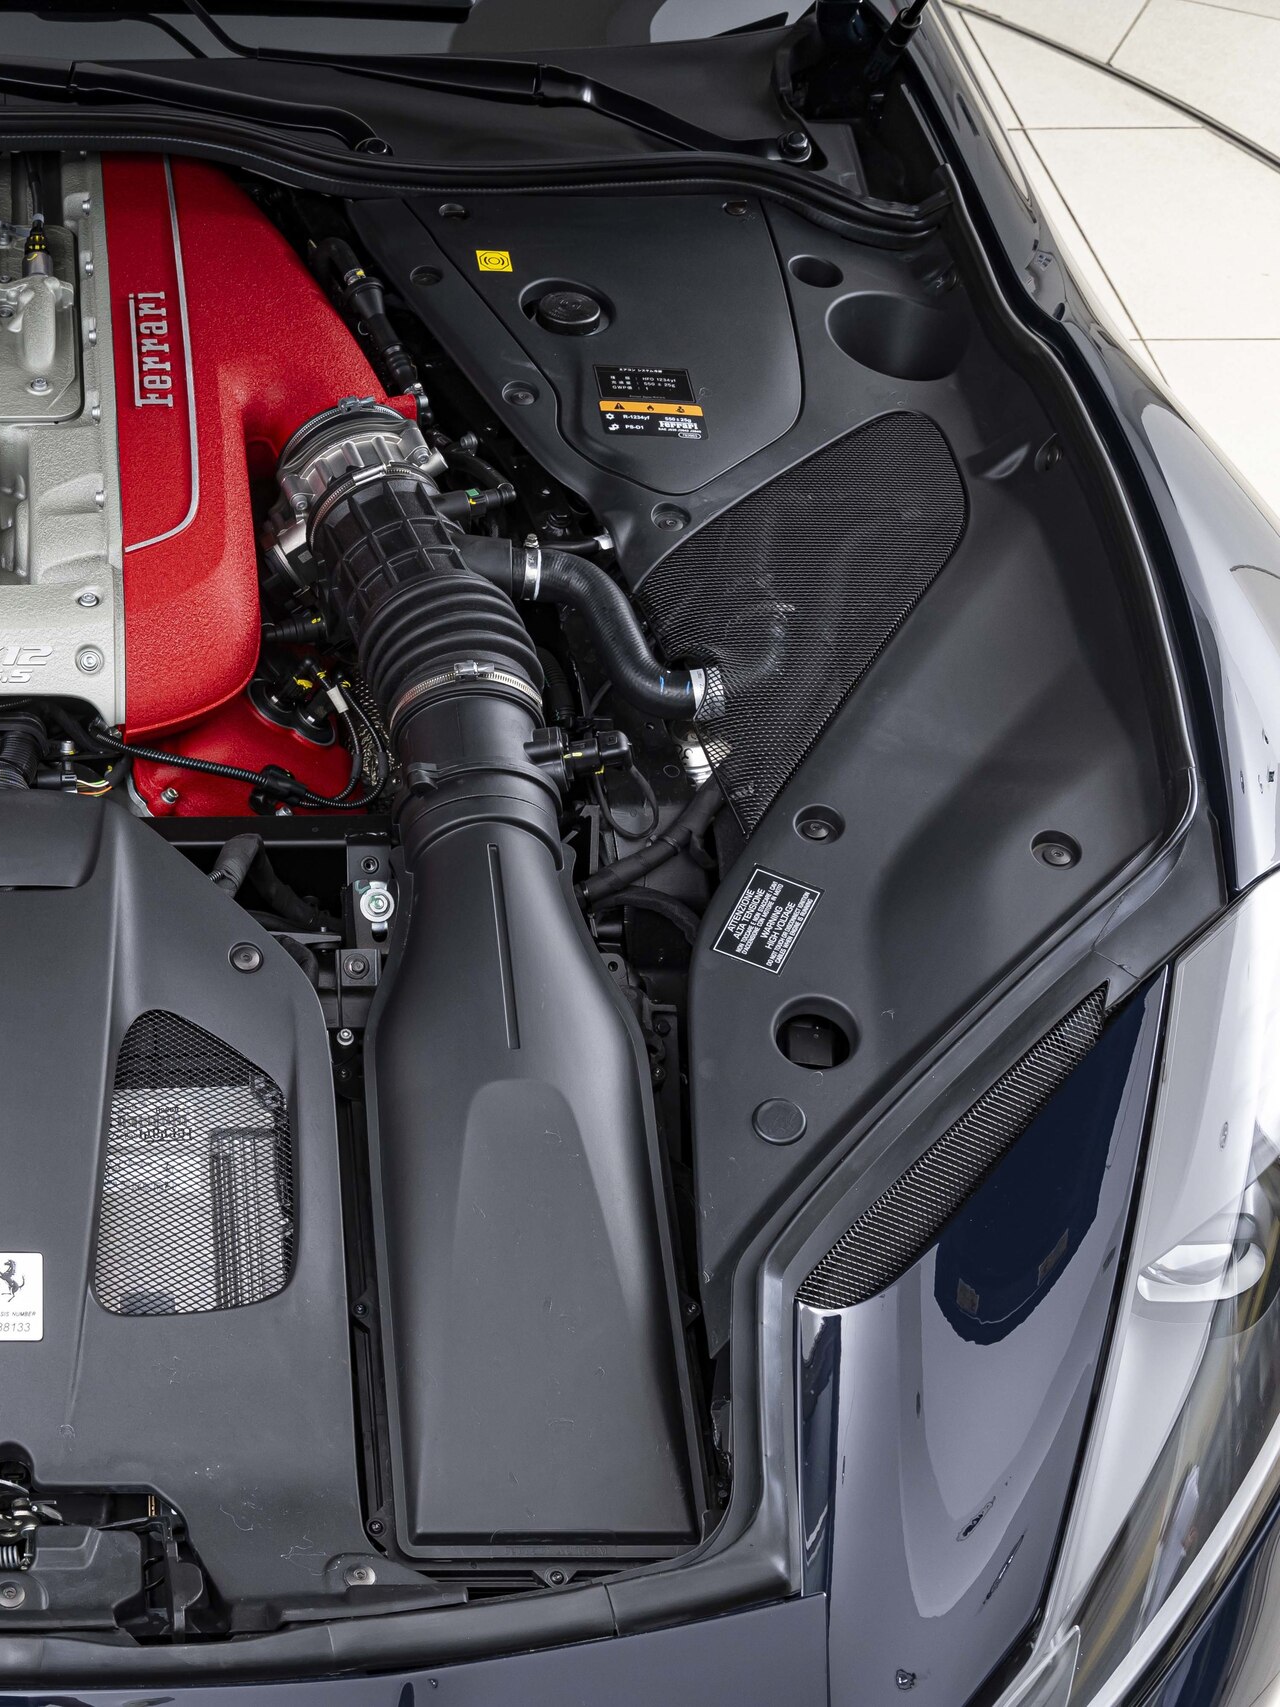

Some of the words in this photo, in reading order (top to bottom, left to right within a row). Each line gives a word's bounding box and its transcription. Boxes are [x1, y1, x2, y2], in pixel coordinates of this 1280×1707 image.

[128, 291, 173, 408] Ferrari
[659, 421, 698, 429] Ferrari
[728, 889, 755, 932] ATTENZIONE
[733, 924, 746, 939] ALTA
[742, 888, 765, 921] TENSIONE
[760, 906, 783, 938] WARNING
[765, 931, 779, 949] HIGH
[775, 902, 795, 930] VOLTAGE
